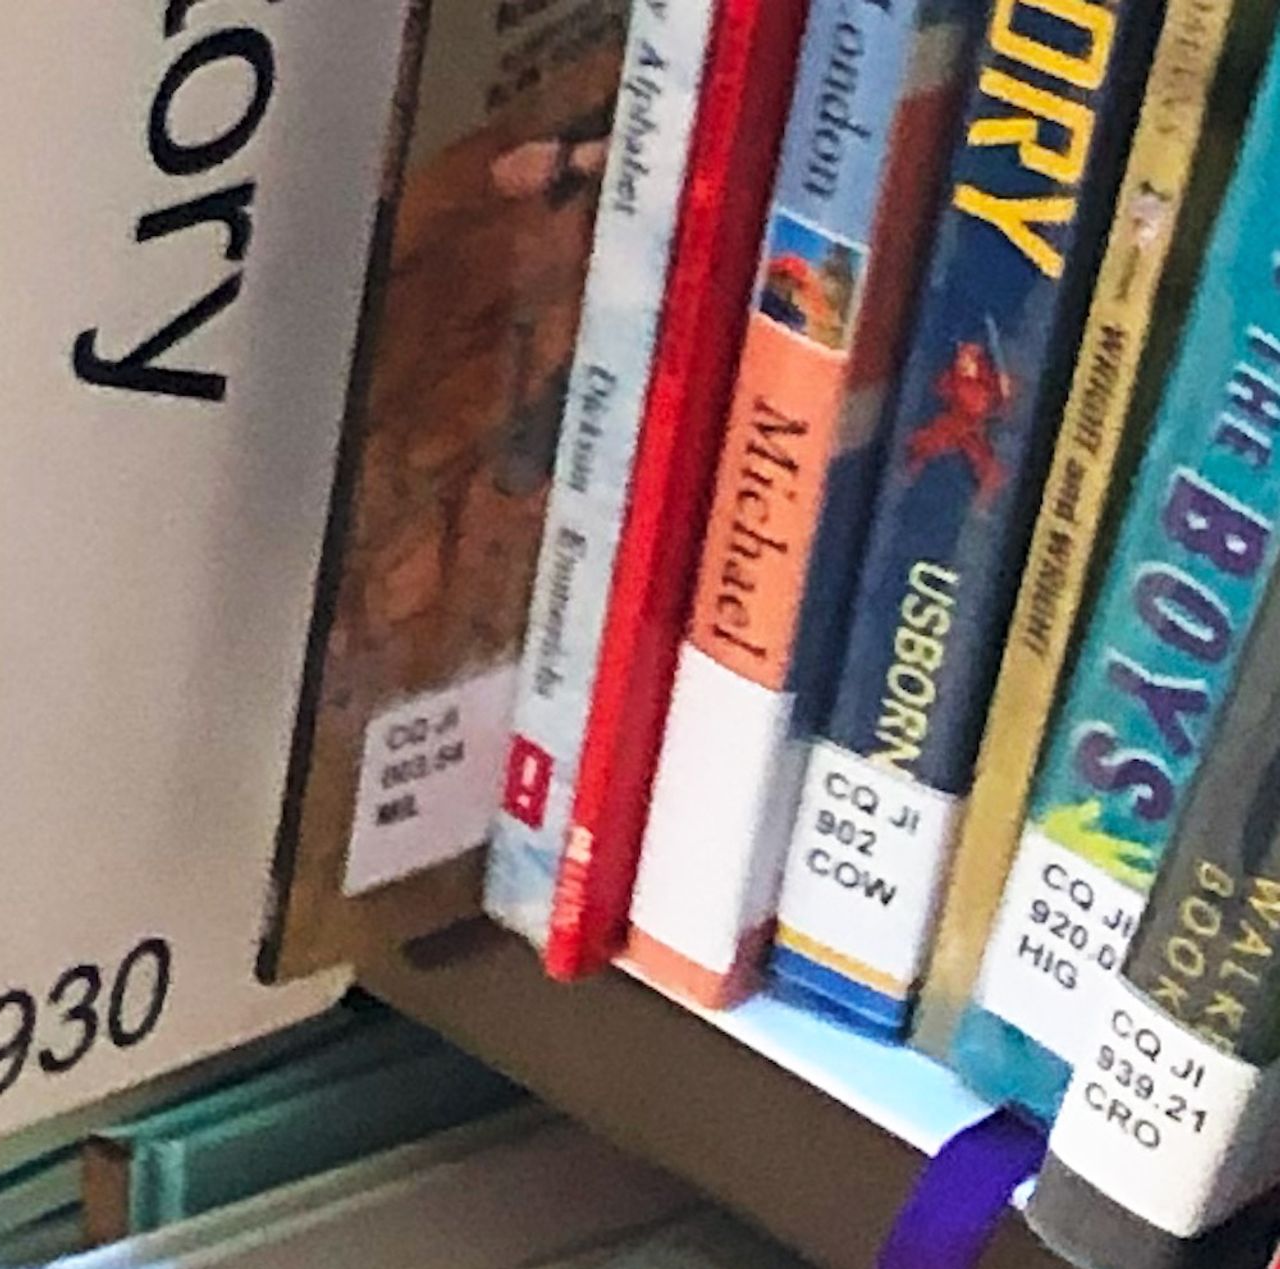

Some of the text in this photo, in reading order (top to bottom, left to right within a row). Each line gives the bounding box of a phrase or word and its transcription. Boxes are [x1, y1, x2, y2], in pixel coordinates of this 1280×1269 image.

[802, 0, 892, 201] ondon
[712, 395, 808, 660] Michael
[1072, 463, 1274, 822] BOYS
[814, 809, 877, 857] 902
[824, 771, 922, 835] CQ JI
[805, 848, 898, 907] COW
[1041, 862, 1135, 941] CQ JI
[1018, 935, 1079, 991] HIG
[1111, 1008, 1207, 1090] CQ JI
[1084, 1081, 1163, 1150] CRO
[1095, 1044, 1209, 1134] 939.21
